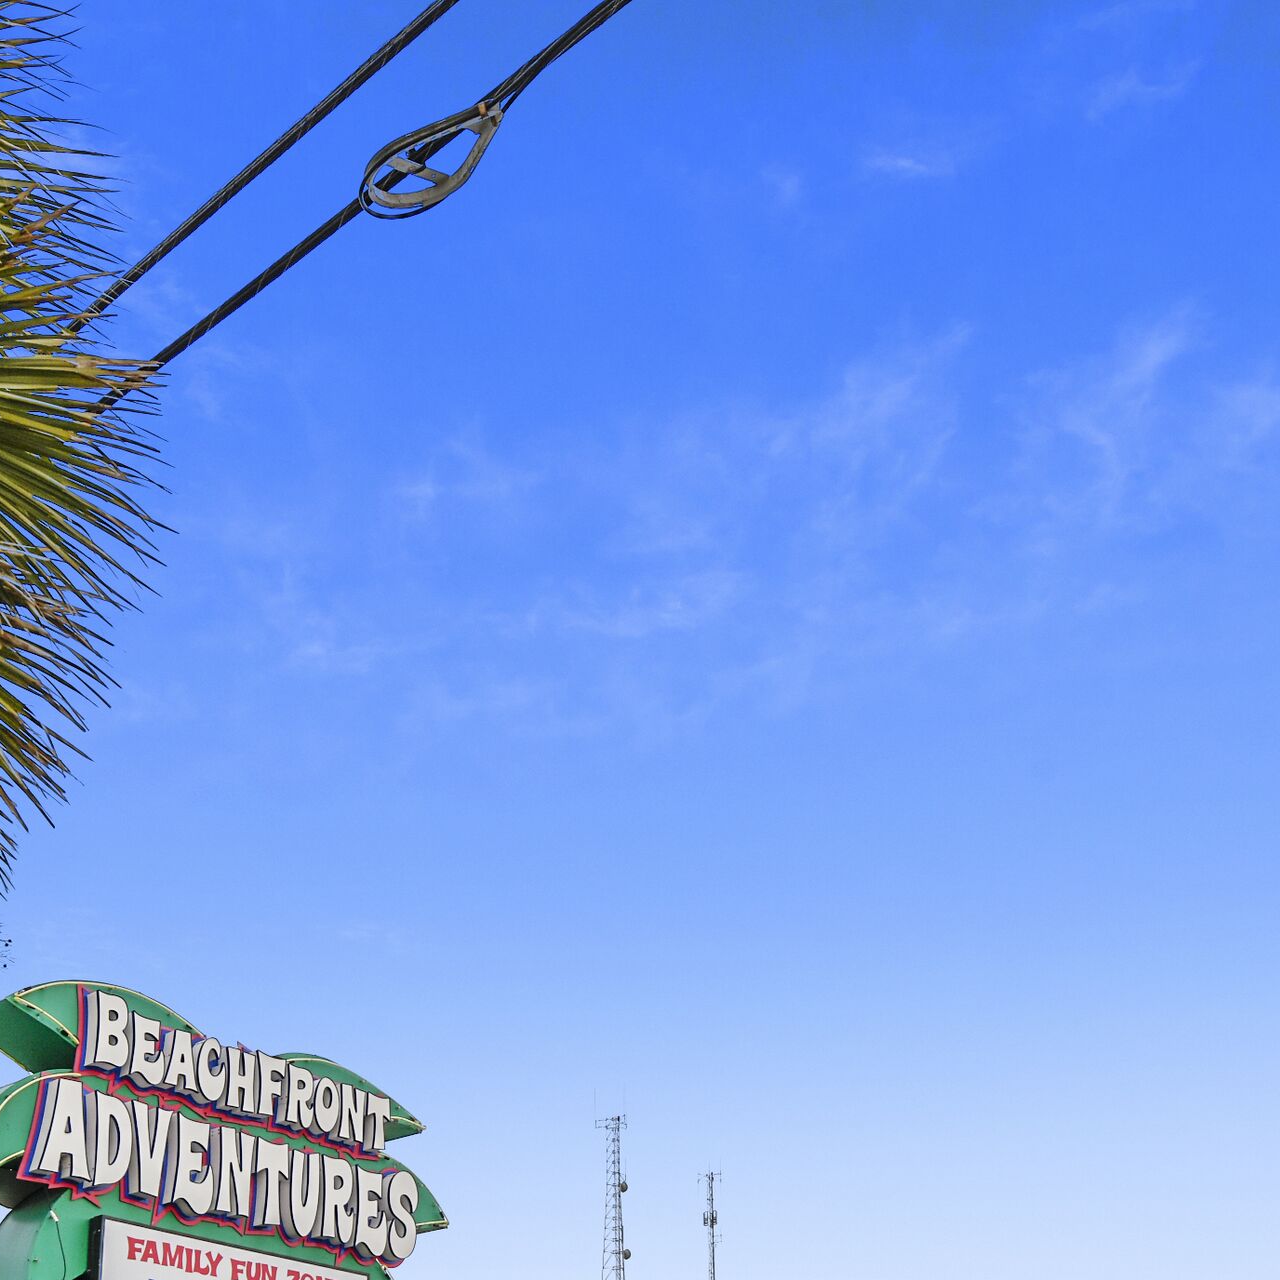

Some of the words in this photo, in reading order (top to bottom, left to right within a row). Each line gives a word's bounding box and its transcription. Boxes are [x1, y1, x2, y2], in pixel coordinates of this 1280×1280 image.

[90, 988, 392, 1151] BEACHFRONT
[35, 1078, 418, 1259] ADVENTURES
[126, 1236, 223, 1277] FAMILY
